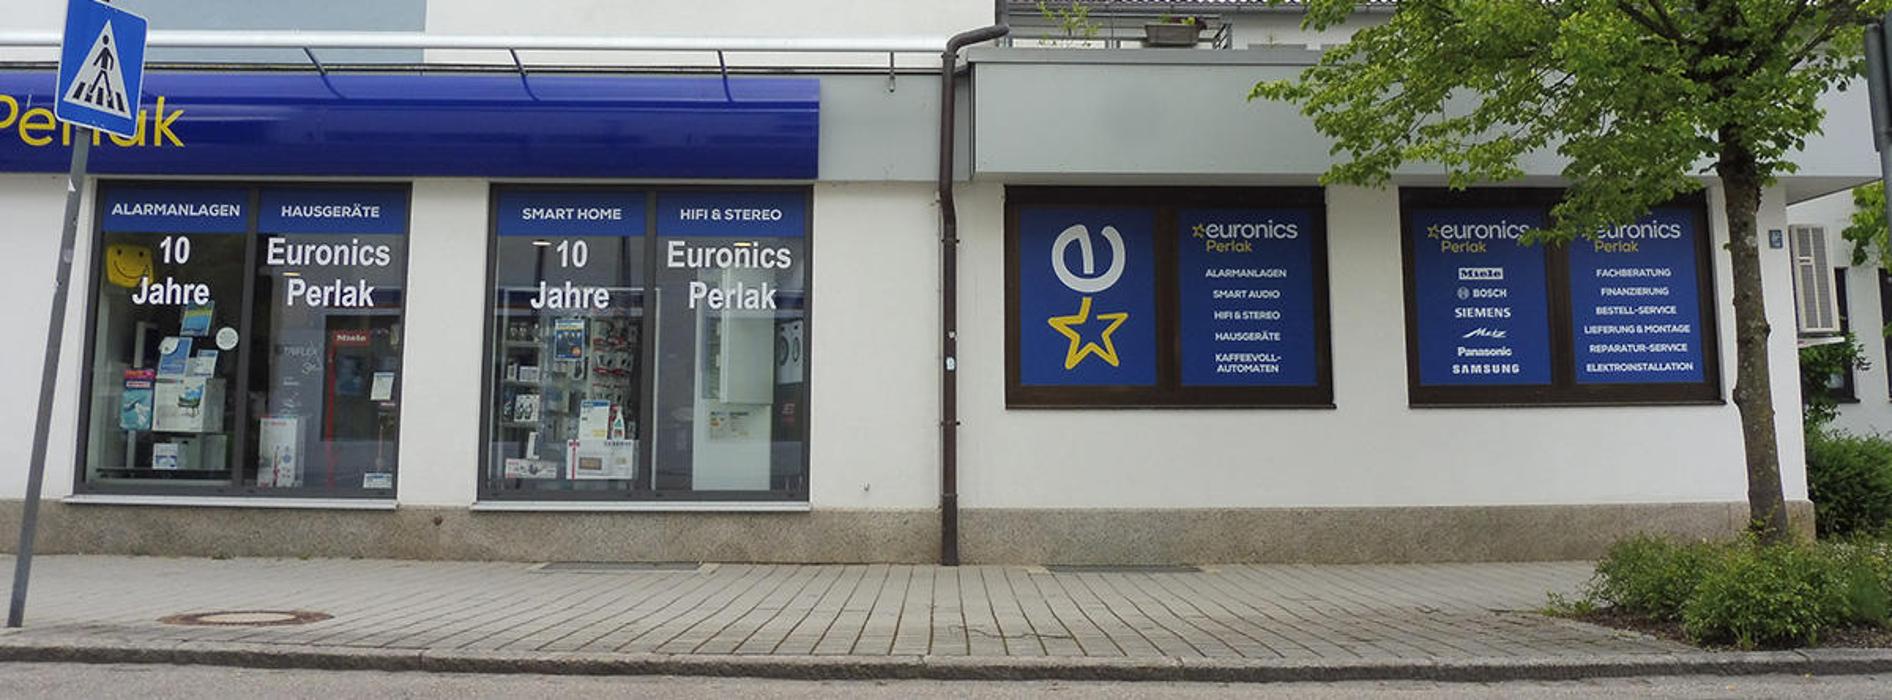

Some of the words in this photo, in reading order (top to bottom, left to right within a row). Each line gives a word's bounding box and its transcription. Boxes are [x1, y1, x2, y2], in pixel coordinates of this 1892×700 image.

[111, 203, 241, 217] ALARMANLAGEN
[281, 203, 380, 218] HAUSGERÄTE
[522, 207, 575, 221] SMART
[577, 208, 622, 220] HOME
[680, 208, 708, 221] HIFI
[712, 209, 721, 221] &
[725, 209, 782, 221] STEREO
[1205, 219, 1298, 239] euronics
[1440, 220, 1530, 240] euronics
[160, 236, 190, 264] 10
[267, 237, 391, 267] Euronics
[1206, 240, 1252, 253] Perlak
[1441, 240, 1487, 253] Perlak
[1595, 240, 1639, 253] Perlak
[557, 240, 587, 268] 10
[667, 240, 791, 269] Euronics
[1205, 269, 1288, 278] ALARMANLAGEN
[1461, 269, 1501, 278] Miele
[1596, 268, 1672, 277] FACHBERATUNG
[132, 277, 210, 305] Jahre
[287, 278, 374, 307] Perlak
[530, 281, 610, 309] Jahre
[689, 282, 777, 309] Perlak
[1213, 290, 1247, 299] SMART
[1248, 290, 1280, 299] AUDIO
[1472, 288, 1508, 298] BOSCH
[1601, 287, 1670, 296] FINANZIERUNG
[1213, 310, 1233, 320] HIFI
[1234, 311, 1242, 320] &
[1243, 311, 1280, 320] STEREO
[1454, 307, 1512, 318] SIEMENS
[1596, 305, 1677, 315] BESTELL-SERVICE
[1462, 327, 1507, 338] Metz
[1584, 324, 1636, 334] LIEFERUNG
[1636, 325, 1644, 333] &
[1645, 324, 1691, 333] MONTAGE
[1215, 331, 1281, 341] HAUSGERÄTE
[1457, 346, 1513, 357] Panasonic
[1589, 343, 1688, 353] REPARATUR-SERVICE
[1215, 353, 1282, 362] KAFFEEVOLL-
[1216, 364, 1280, 373] AUTOMATEN
[1452, 364, 1520, 374] SAMSUNG
[1586, 362, 1694, 372] ELEKTROINSTALLATION
